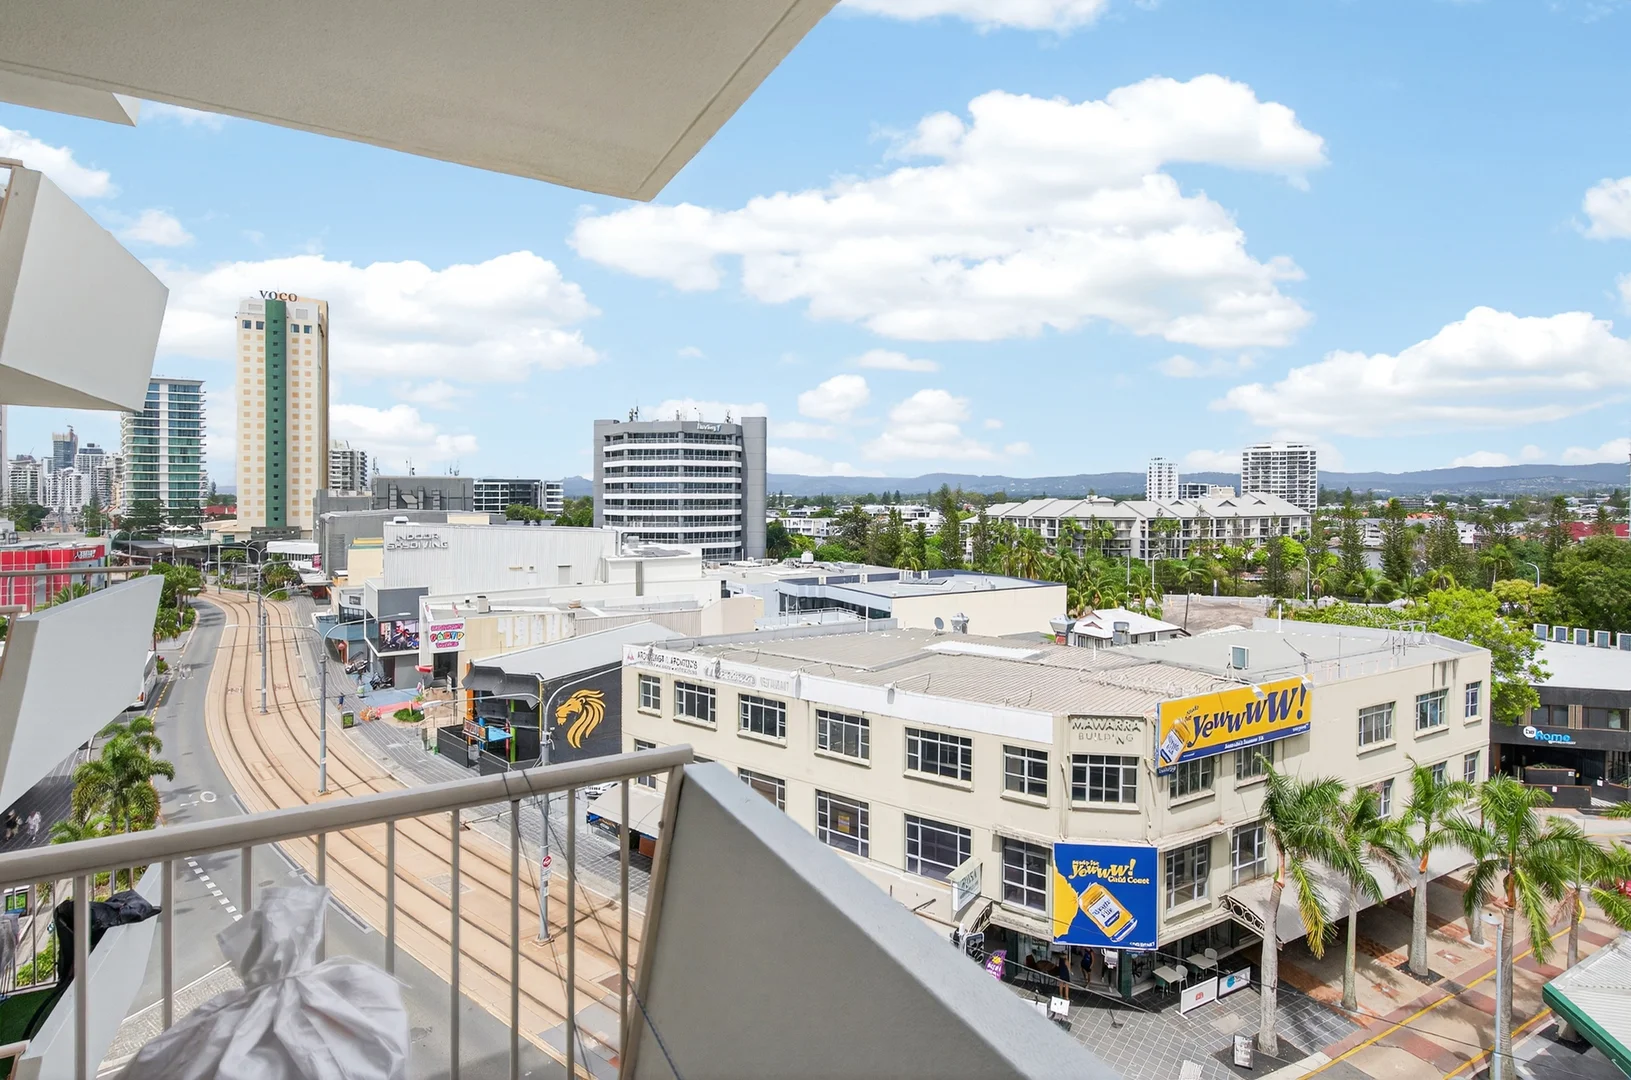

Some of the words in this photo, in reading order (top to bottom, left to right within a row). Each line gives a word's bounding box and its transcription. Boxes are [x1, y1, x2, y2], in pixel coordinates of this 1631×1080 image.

[1072, 718, 1142, 732] MAWARRA
[1107, 876, 1126, 884] Gold
[1127, 877, 1150, 885] Coast
